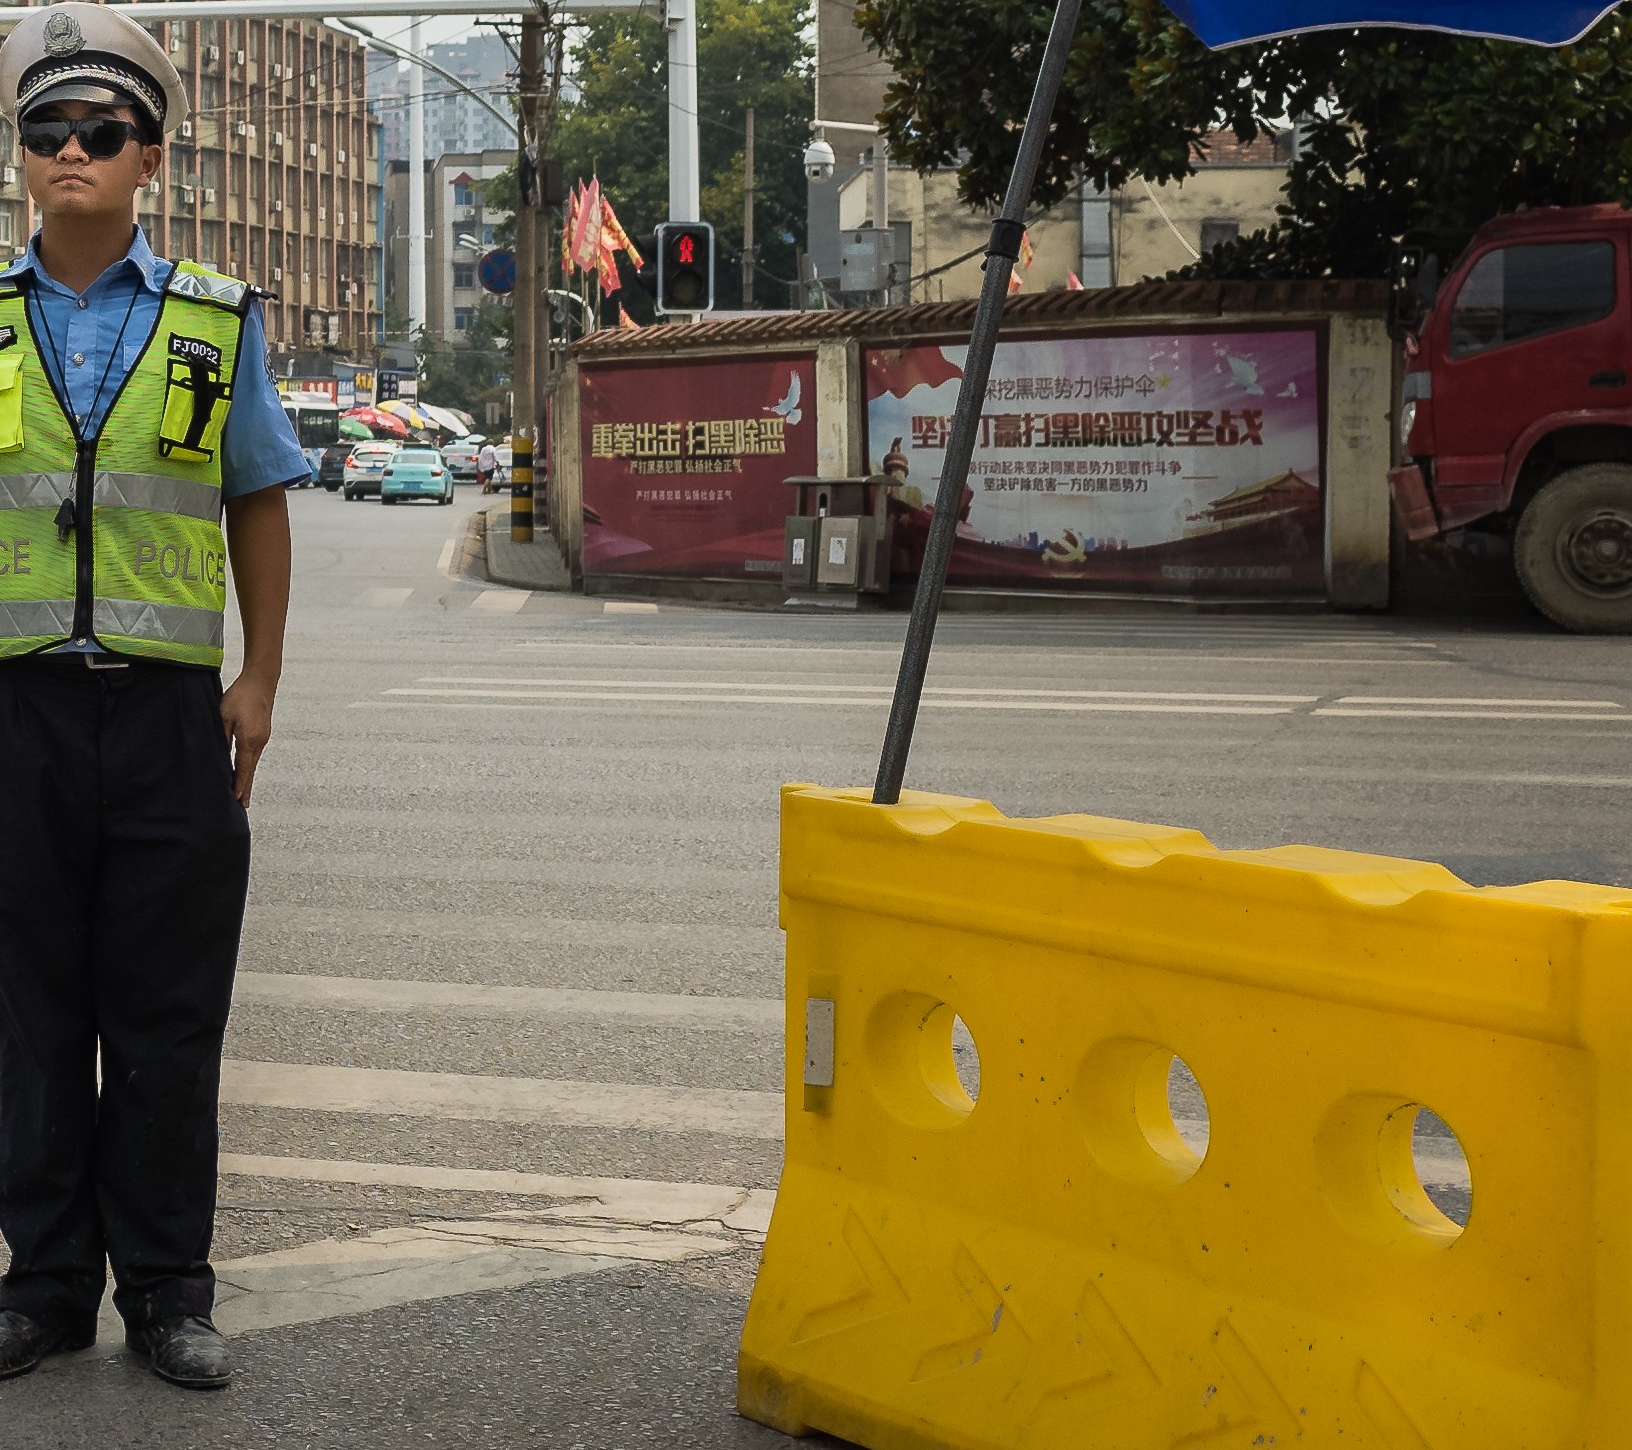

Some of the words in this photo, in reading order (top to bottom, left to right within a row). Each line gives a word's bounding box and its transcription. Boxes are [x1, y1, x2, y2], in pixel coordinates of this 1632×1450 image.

[592, 421, 681, 457] 重拳出击
[686, 418, 785, 455] 扫黑除恶
